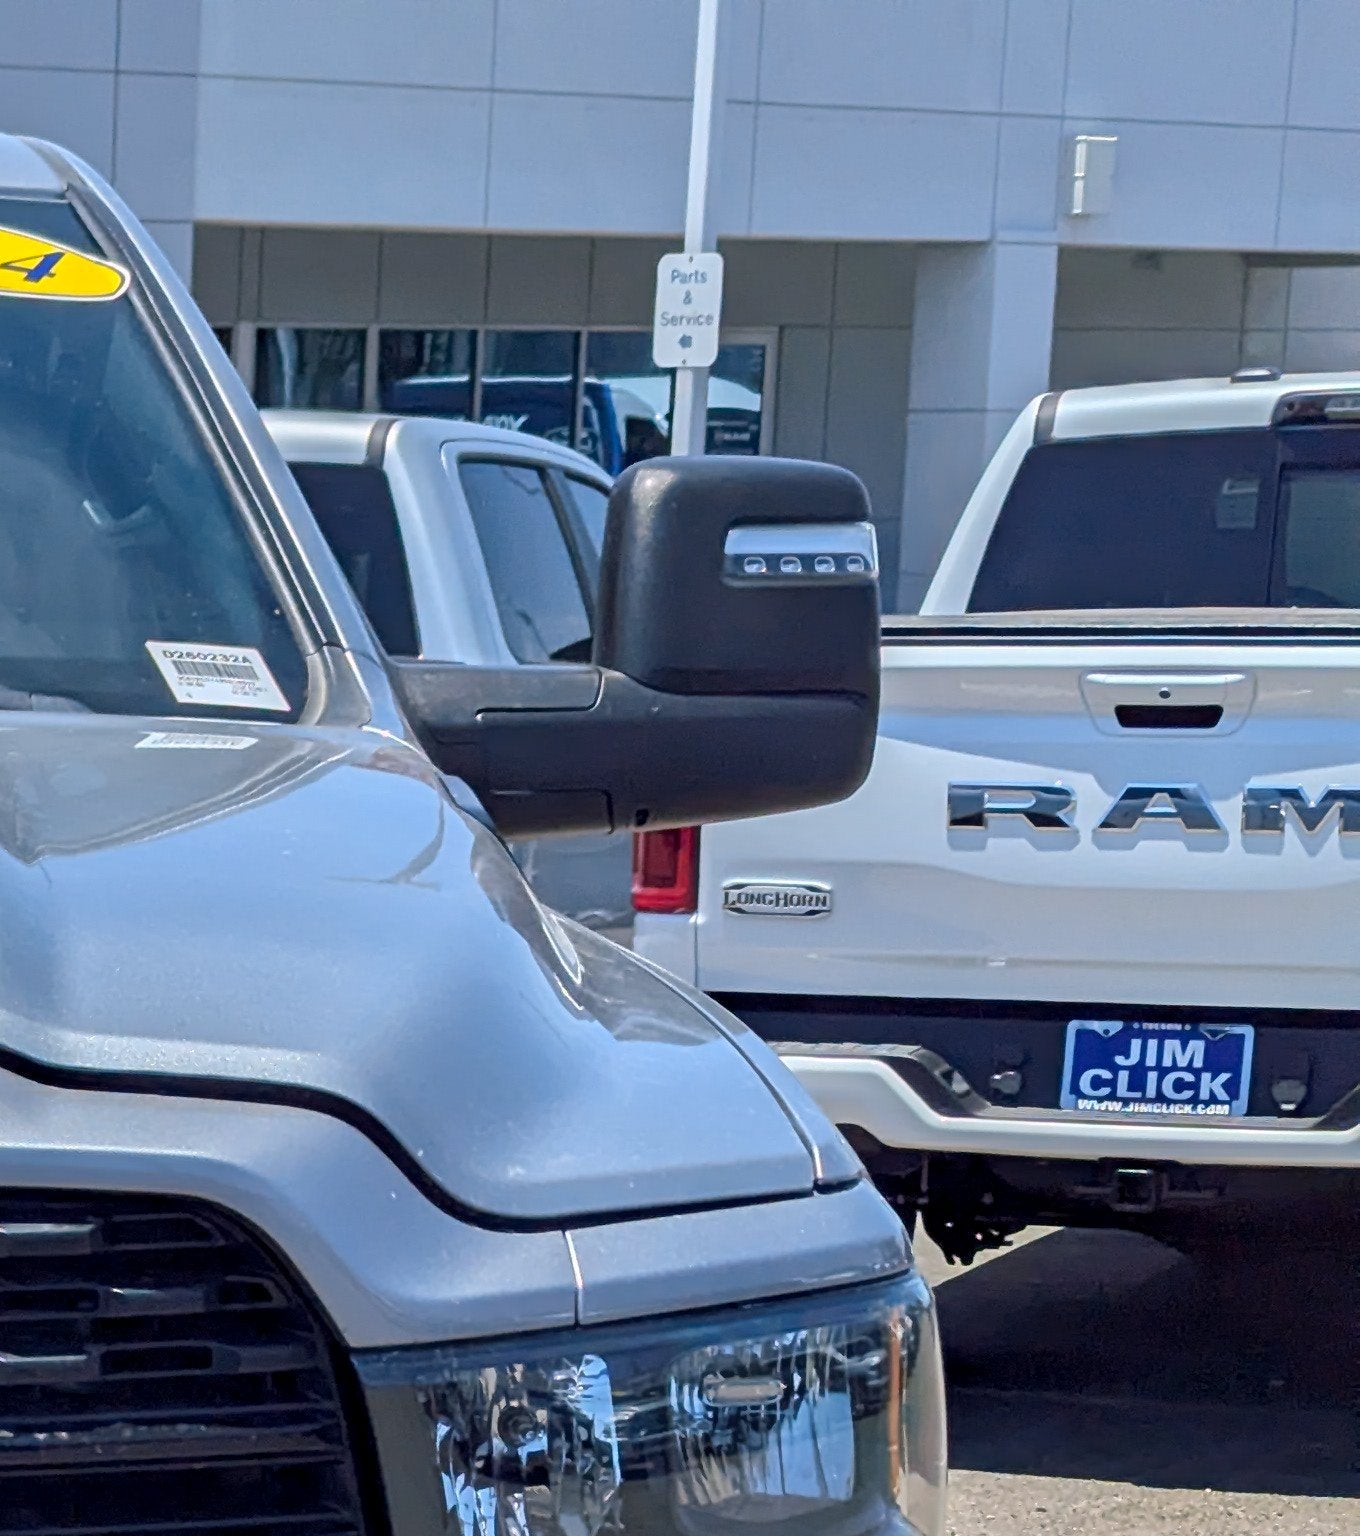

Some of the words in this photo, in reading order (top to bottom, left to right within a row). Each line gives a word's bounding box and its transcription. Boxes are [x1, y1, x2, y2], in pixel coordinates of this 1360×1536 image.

[670, 268, 708, 284] Parts
[682, 289, 693, 305] &
[660, 311, 715, 327] Service
[946, 778, 1360, 836] RAM
[723, 891, 828, 908] LONGHORN
[1113, 1037, 1206, 1069] JIM
[1078, 1067, 1234, 1101] CLICK
[1077, 1099, 1230, 1115] WWW.JIMCLICK.COM
